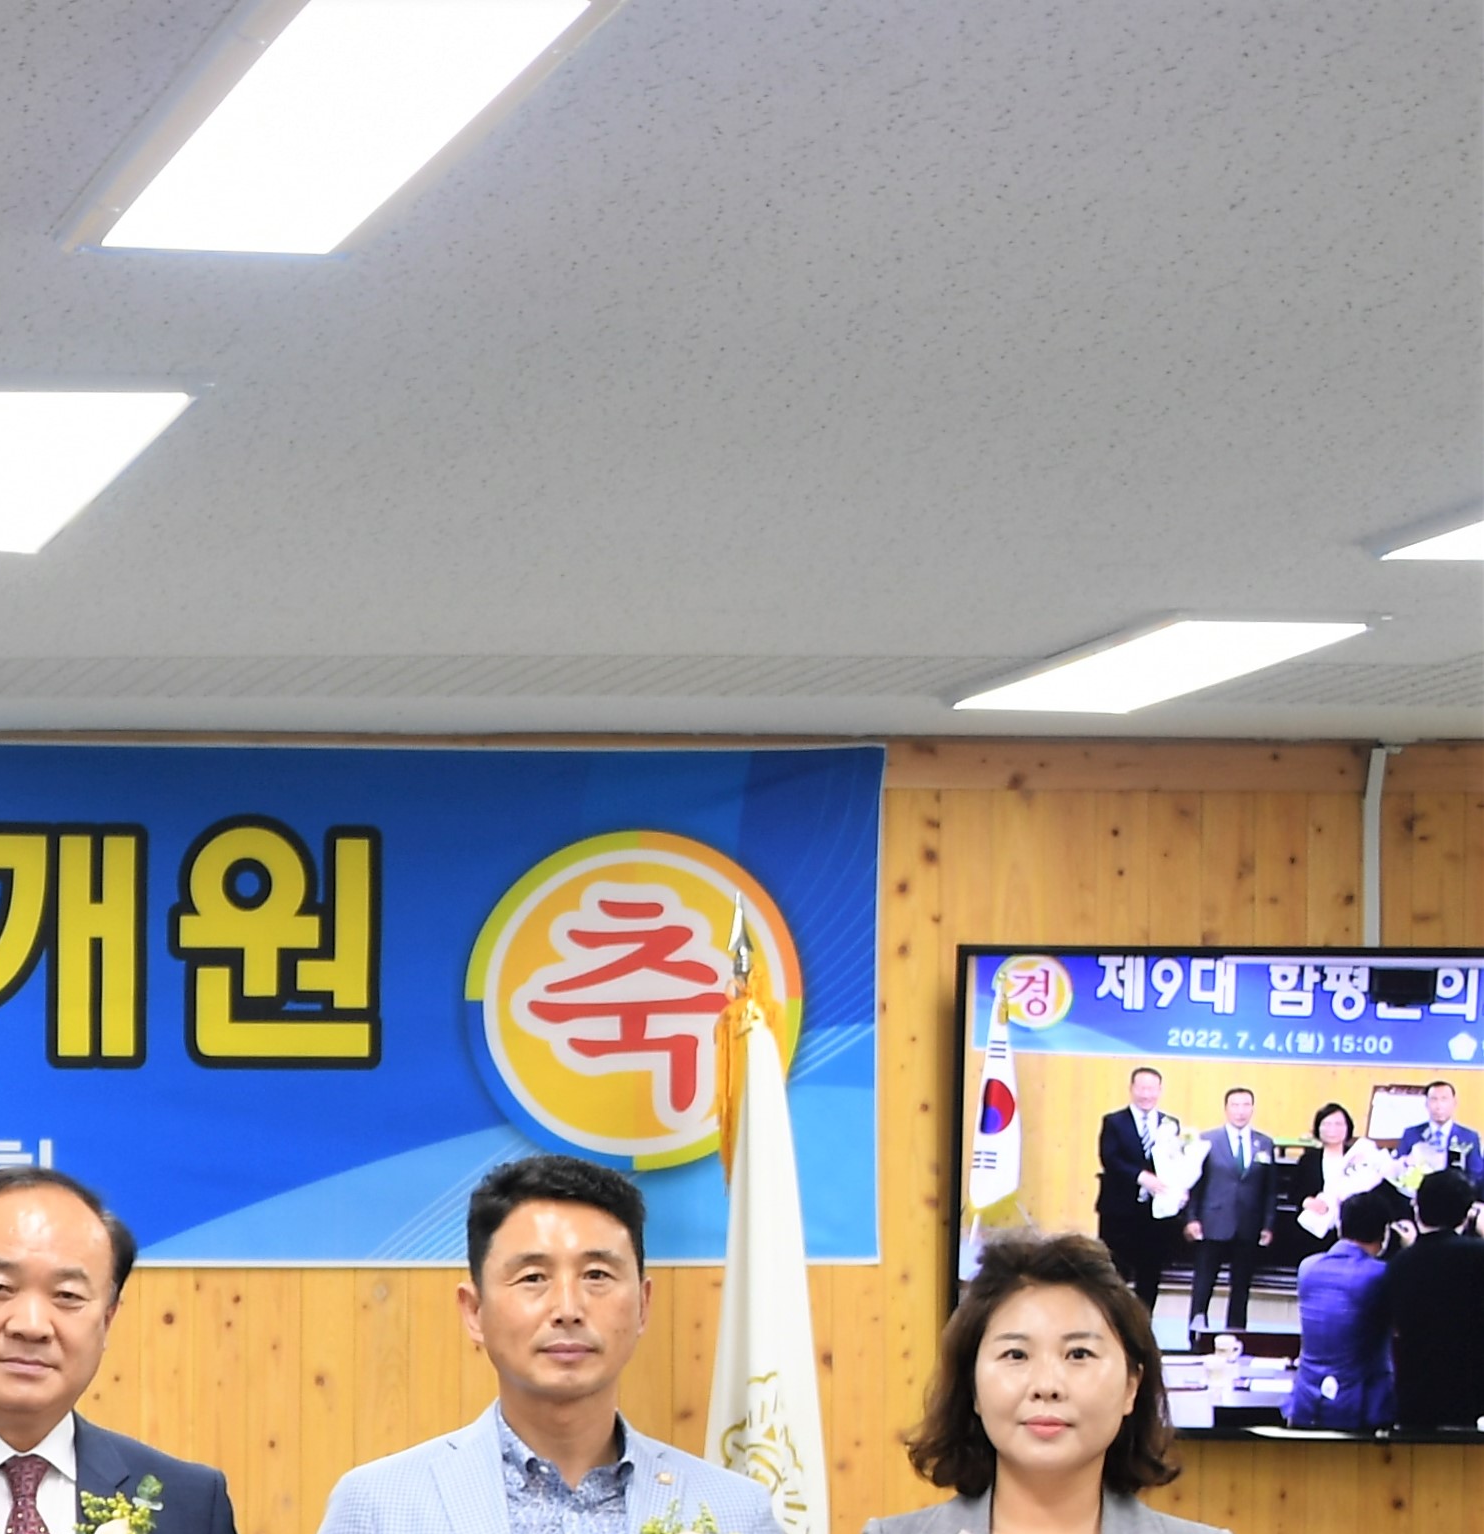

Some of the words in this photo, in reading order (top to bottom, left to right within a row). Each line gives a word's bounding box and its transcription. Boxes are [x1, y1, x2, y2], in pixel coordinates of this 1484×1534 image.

[527, 897, 730, 1114] 축
[1008, 967, 1050, 1017] 경
[1095, 955, 1237, 1015] 제9대
[1331, 1035, 1394, 1055] 15:00
